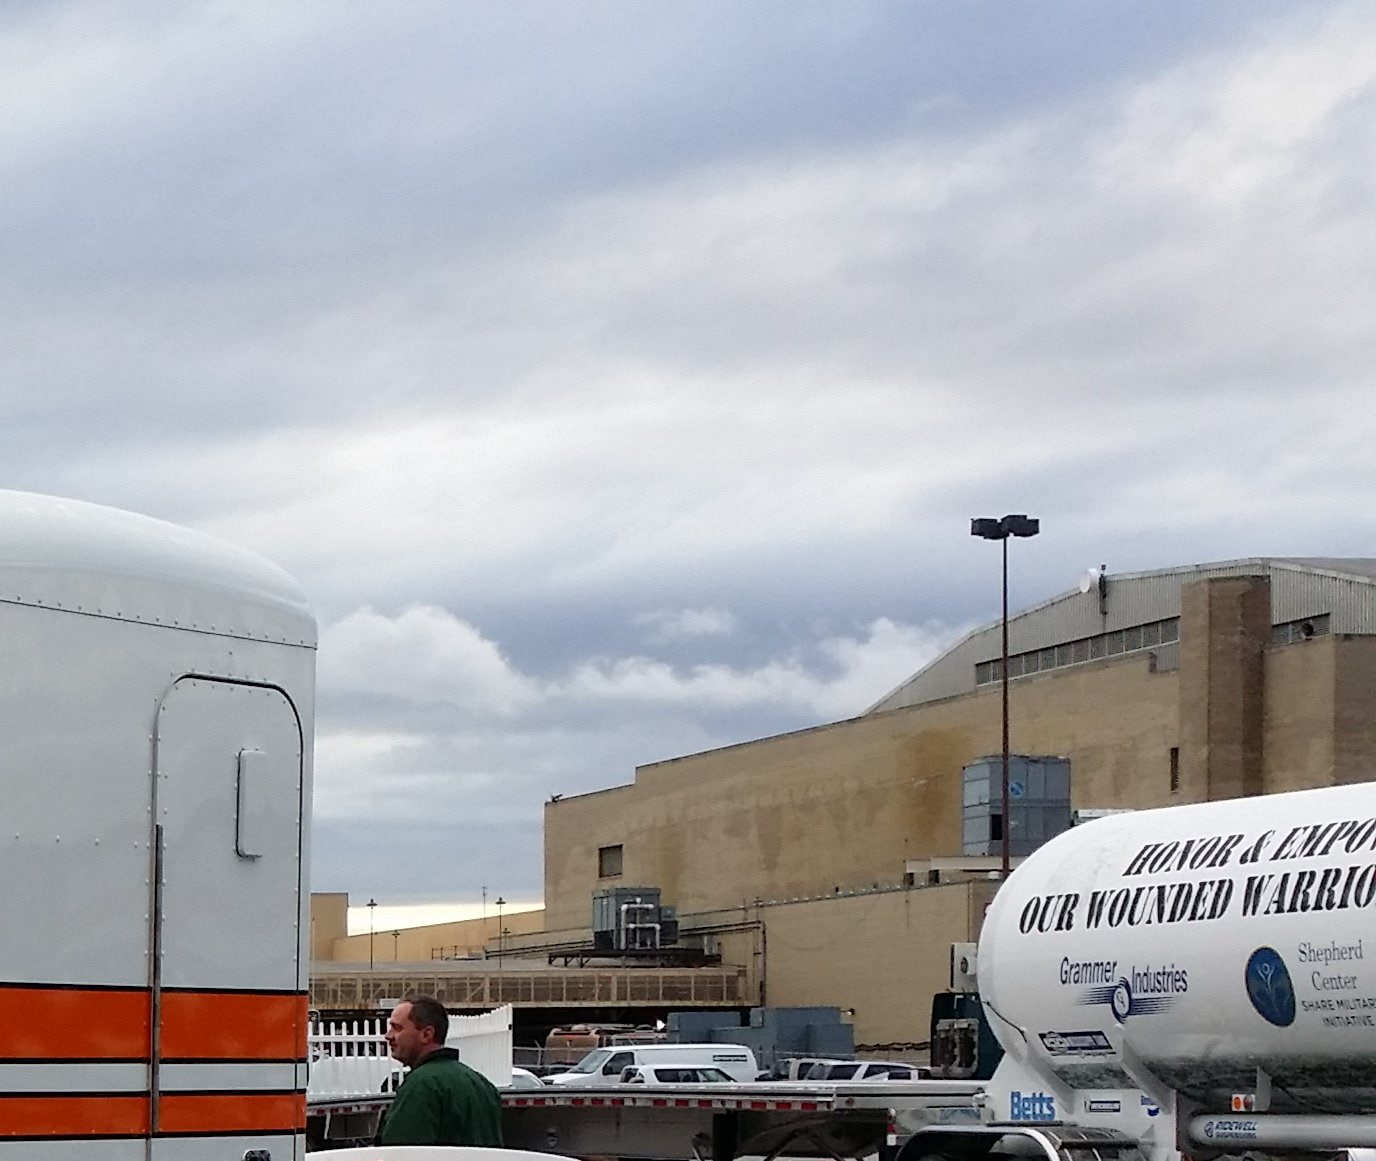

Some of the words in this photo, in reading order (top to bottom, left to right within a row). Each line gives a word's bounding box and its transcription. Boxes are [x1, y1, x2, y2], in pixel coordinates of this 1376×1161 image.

[1122, 833, 1245, 876] HONOR
[1239, 829, 1275, 865] &
[1270, 818, 1376, 862] EMPO
[1019, 893, 1079, 934] OUR
[1086, 878, 1234, 930] WOUNDED
[1298, 939, 1363, 966] Shepherd
[1060, 956, 1118, 985] Grammer
[1131, 963, 1188, 995] Industries
[1311, 971, 1357, 991] Center
[1301, 999, 1335, 1011] SHARE
[1010, 1091, 1056, 1121] Betts
